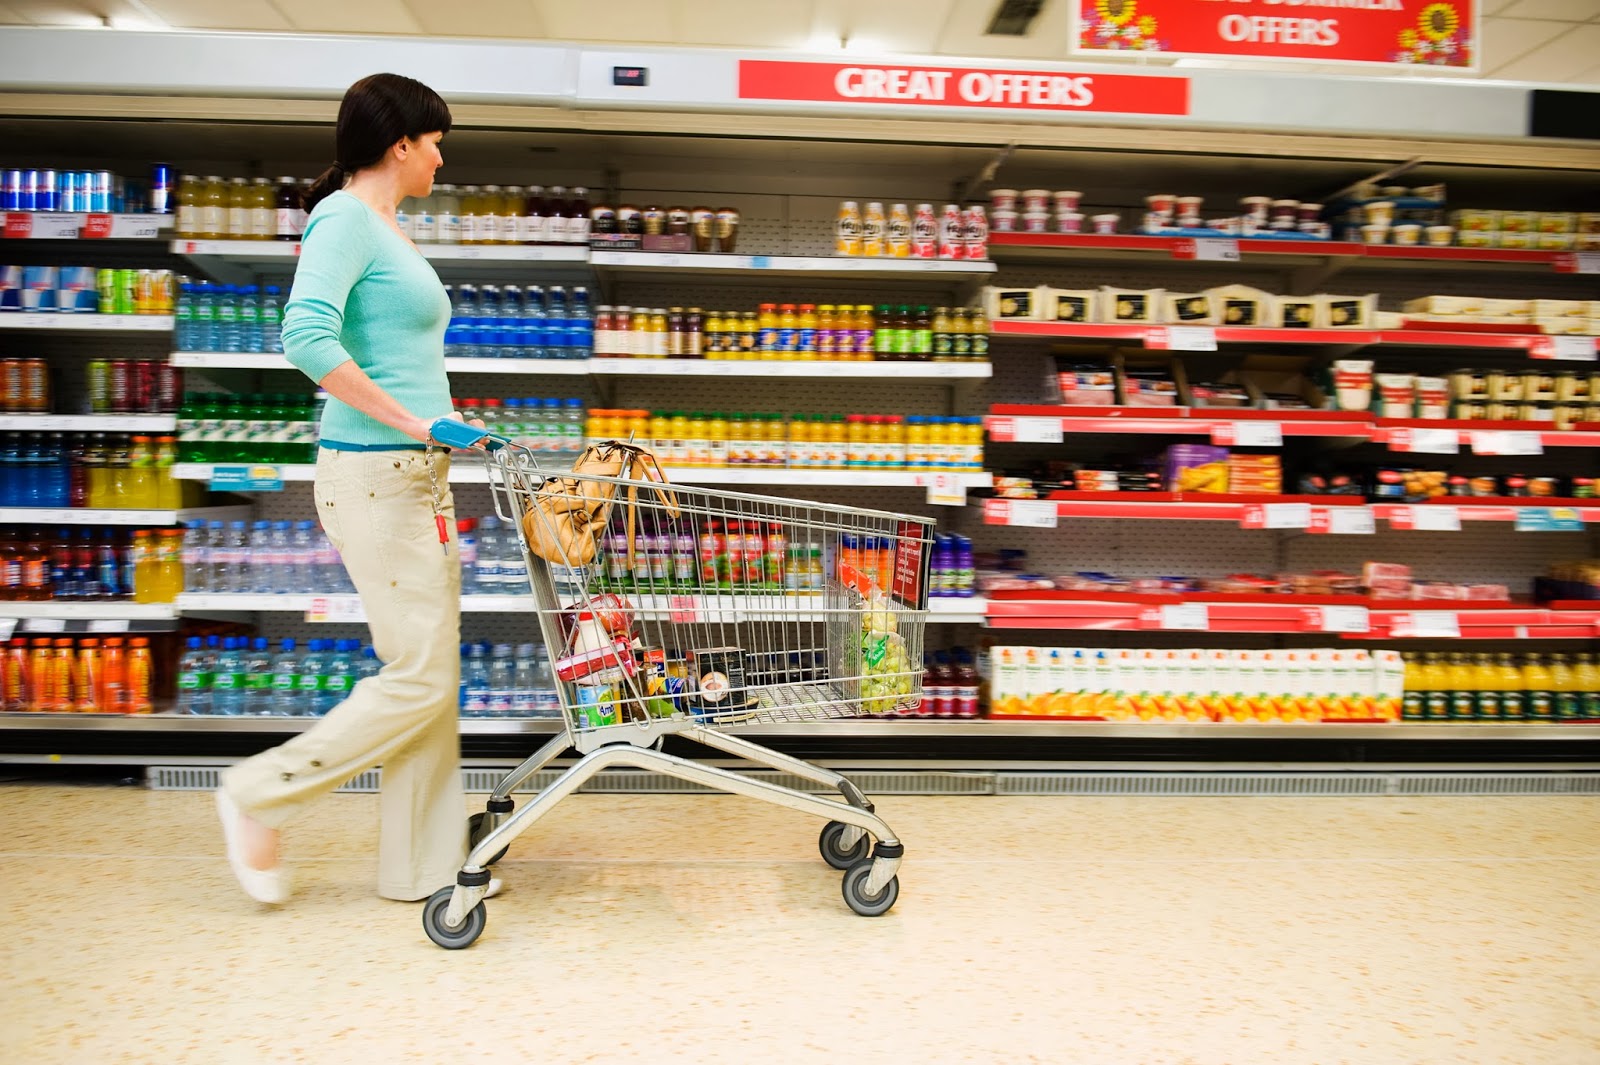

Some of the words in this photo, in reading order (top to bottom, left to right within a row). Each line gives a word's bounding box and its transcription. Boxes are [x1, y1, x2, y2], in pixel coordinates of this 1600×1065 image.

[1217, 14, 1340, 46] OFFERS
[834, 67, 952, 100] GREAT
[958, 72, 1094, 106] OFFERS
